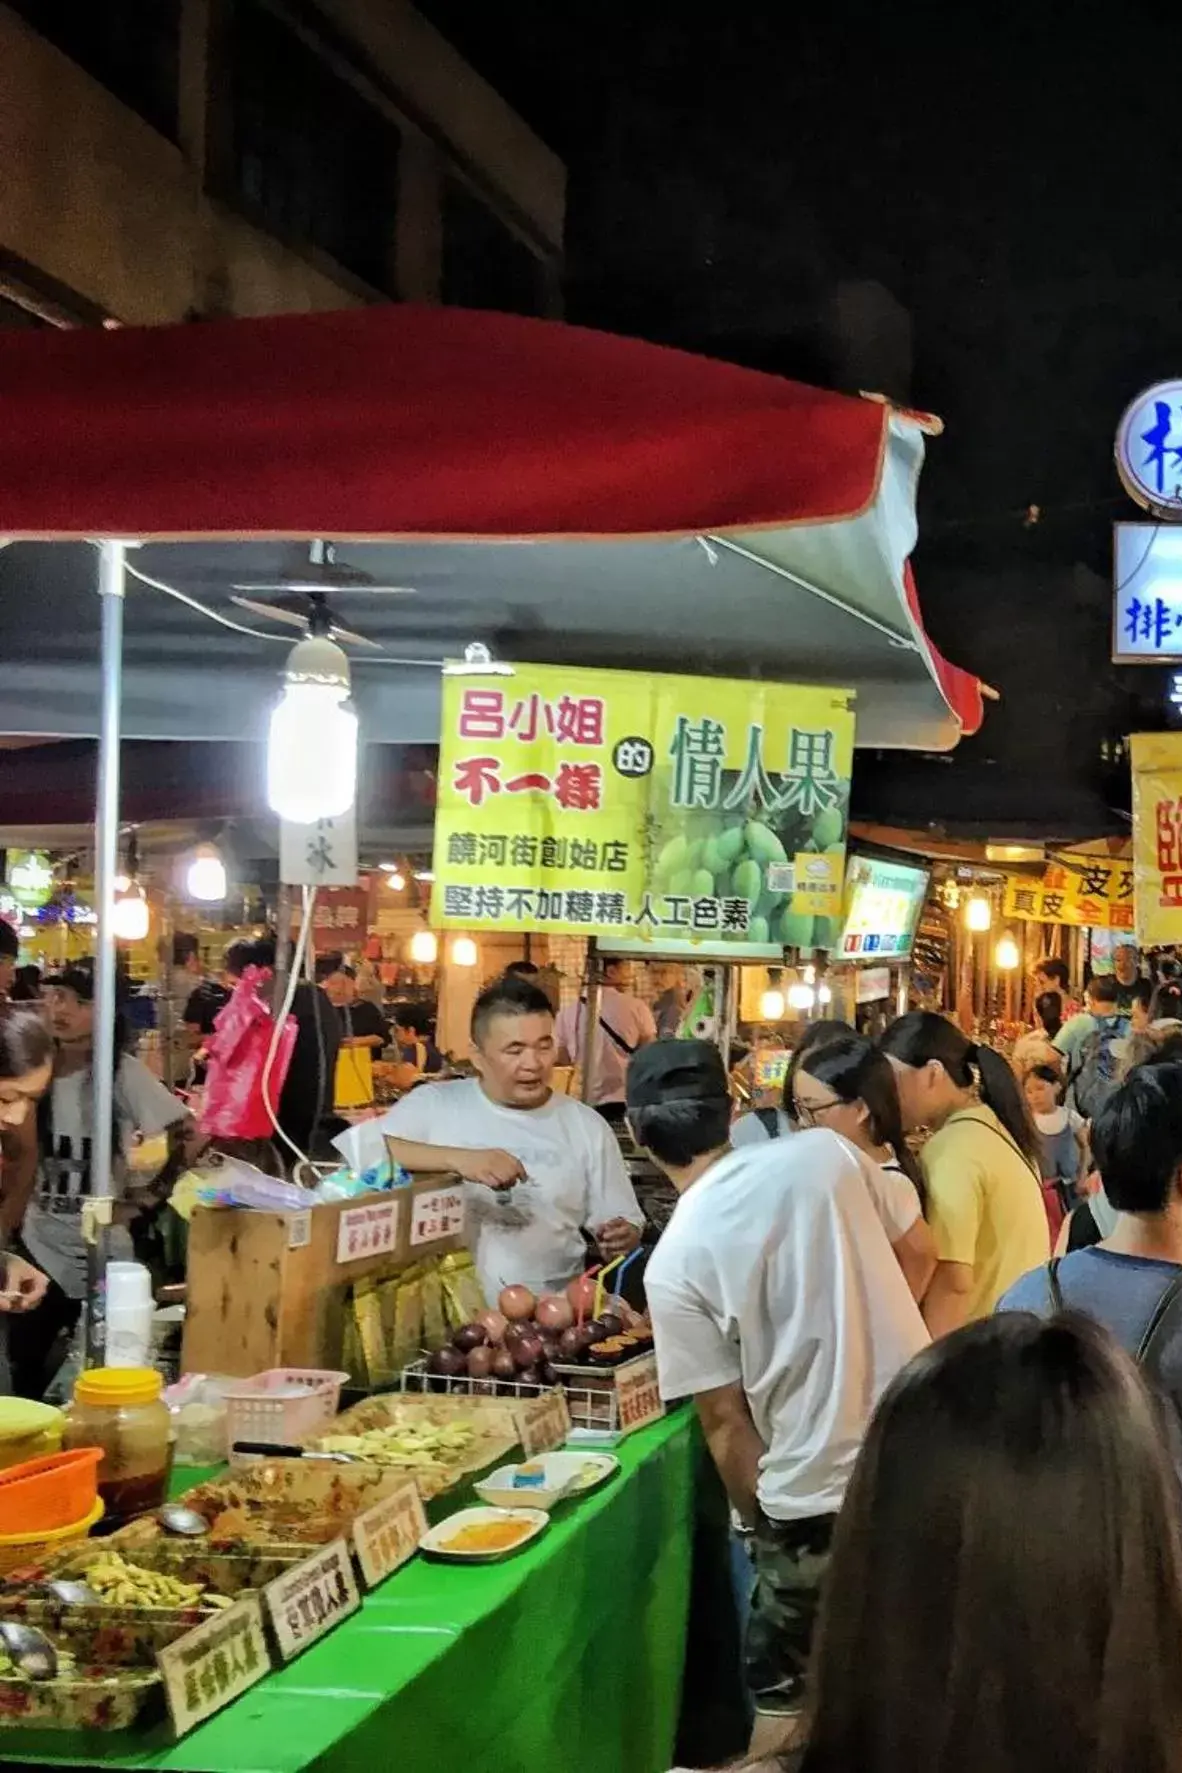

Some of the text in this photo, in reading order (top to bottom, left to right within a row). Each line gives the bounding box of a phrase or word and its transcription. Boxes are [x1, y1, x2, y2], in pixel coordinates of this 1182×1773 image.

[460, 690, 604, 745] 呂小姐
[615, 741, 651, 774] 的
[669, 716, 838, 815] 情人果
[446, 832, 629, 871] 饒河街創始店
